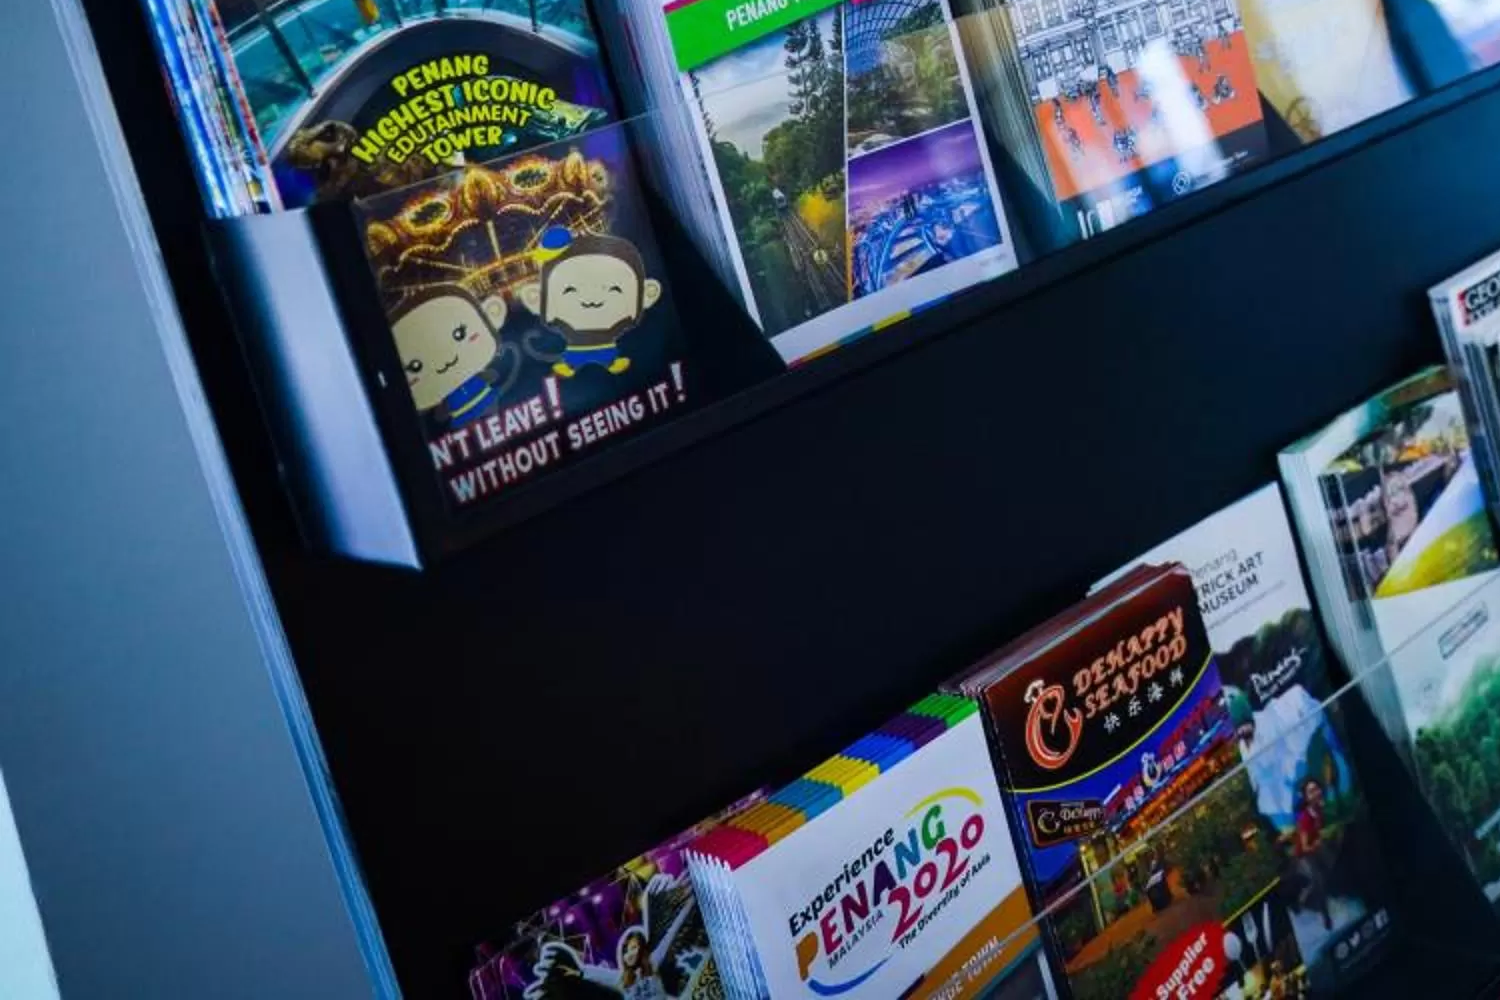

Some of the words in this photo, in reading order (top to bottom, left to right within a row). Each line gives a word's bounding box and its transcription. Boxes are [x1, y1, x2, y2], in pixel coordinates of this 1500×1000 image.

[390, 54, 490, 97] PENANG
[351, 83, 457, 164] HIGHEST
[461, 78, 556, 110] ICONIC
[387, 104, 532, 164] EDUTAINMENT
[421, 125, 502, 165] TOWER
[450, 434, 562, 503] WITHOUT
[567, 395, 645, 450] SEEING
[1191, 548, 1237, 579] enang
[1200, 572, 1258, 614] MUSEUM
[1238, 550, 1264, 577] ART
[1086, 635, 1187, 718] SEAFOOD
[788, 827, 895, 938] Experience
[796, 804, 946, 982] PENANG
[887, 813, 985, 944] 2020
[828, 908, 885, 970] MALAYSIA
[898, 929, 917, 949] The
[917, 885, 961, 932] Diversity
[960, 874, 972, 889] of
[1156, 932, 1208, 1000] Supplier
[1177, 957, 1215, 1000] Free
